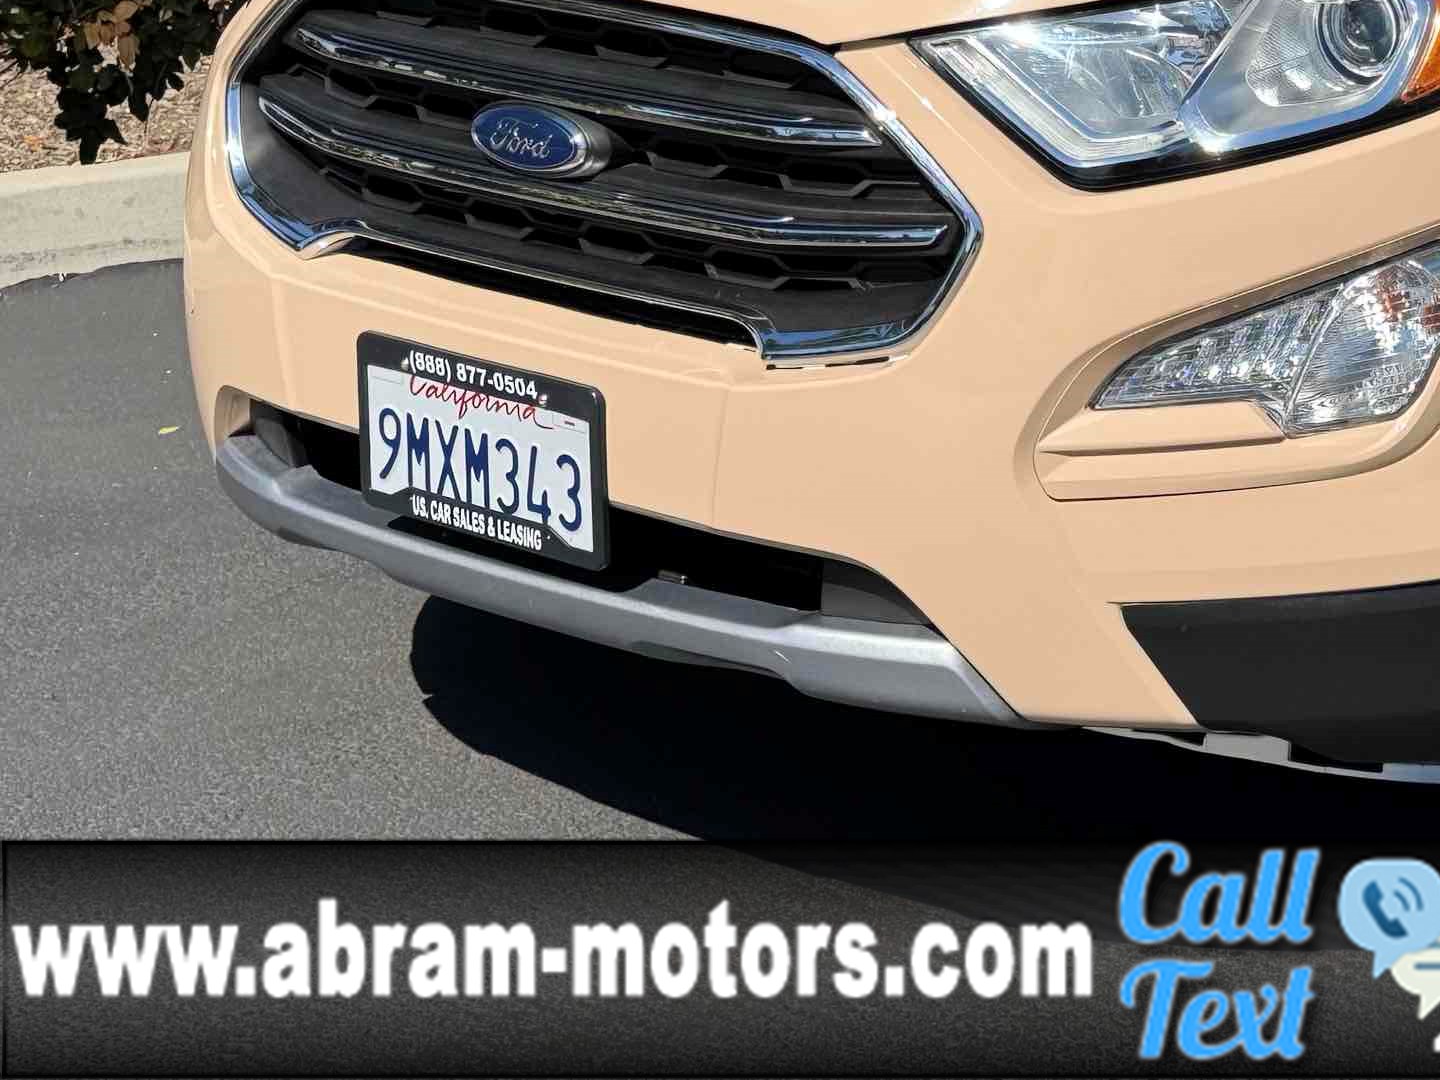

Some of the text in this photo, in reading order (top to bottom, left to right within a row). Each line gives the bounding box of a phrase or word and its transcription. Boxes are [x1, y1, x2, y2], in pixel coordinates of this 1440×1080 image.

[490, 116, 553, 159] Ford
[409, 349, 539, 400] (888) 877-0504
[379, 408, 583, 532] 9MXM343
[430, 500, 452, 526] CAR
[452, 507, 486, 535] SALES
[487, 516, 496, 538] &
[497, 518, 543, 551] LEASING
